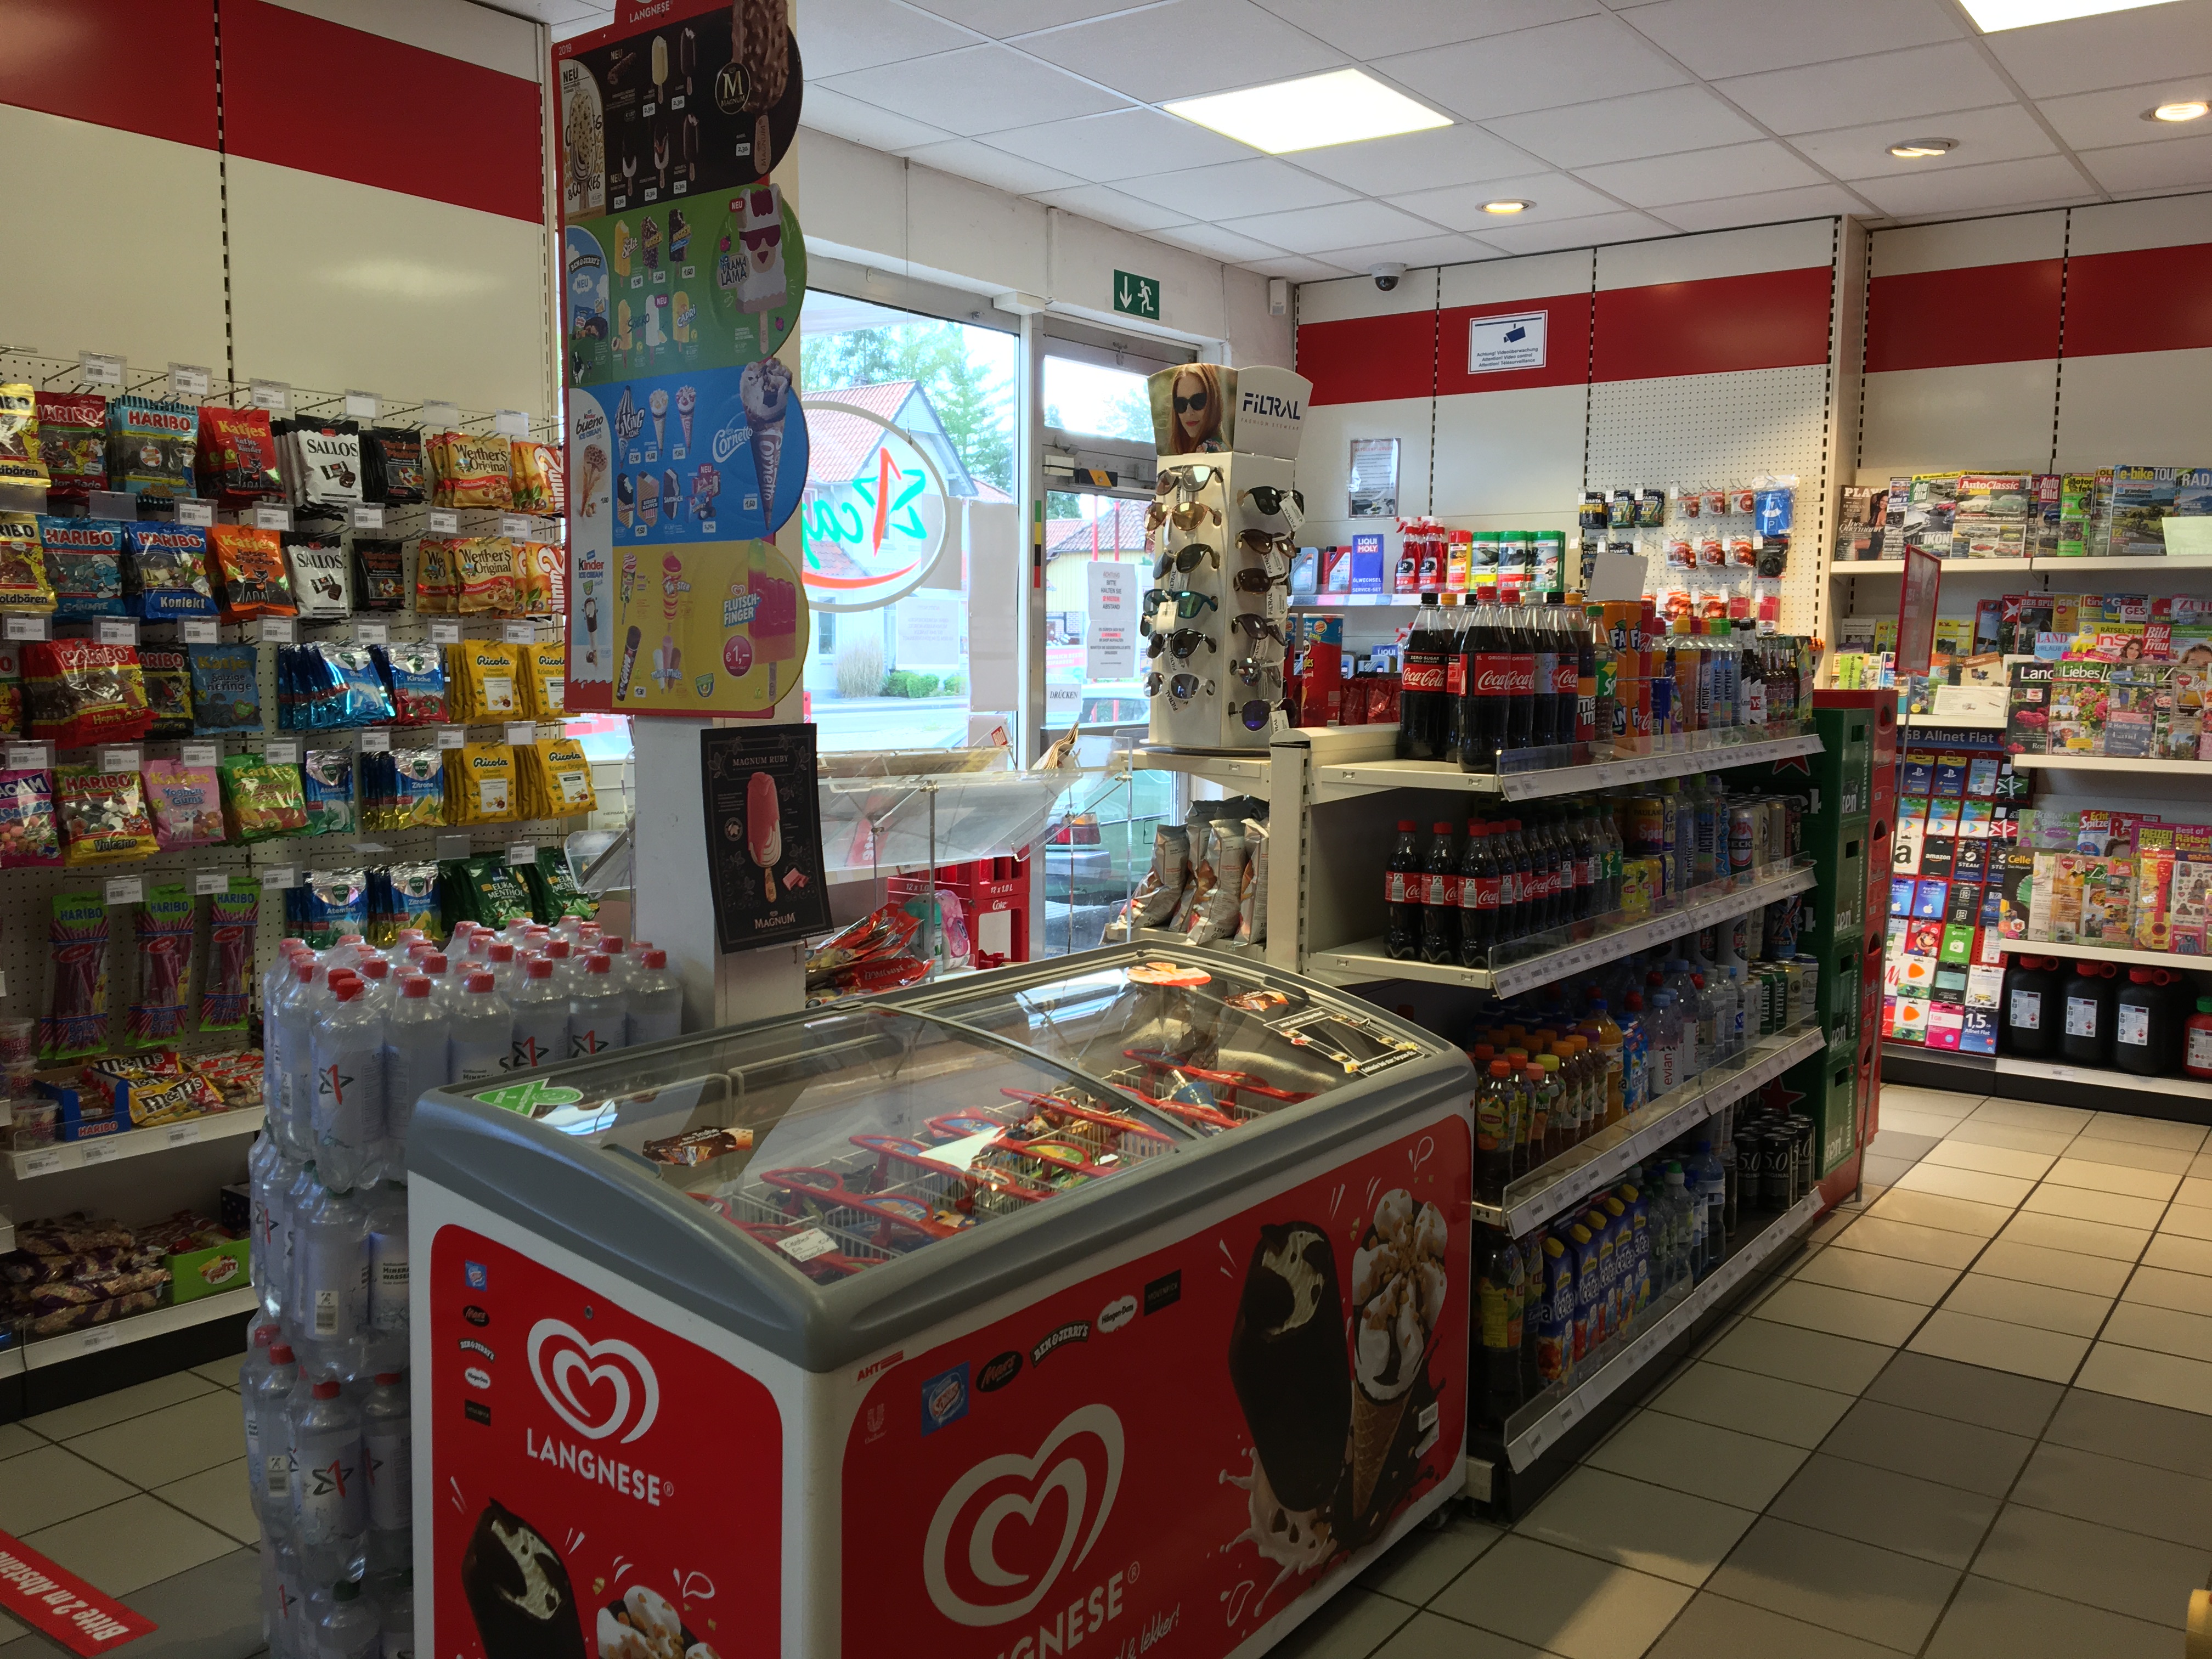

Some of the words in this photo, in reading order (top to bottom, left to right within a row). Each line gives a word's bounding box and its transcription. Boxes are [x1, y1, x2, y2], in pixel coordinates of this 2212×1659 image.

[558, 43, 572, 54] 2019
[610, 49, 623, 60] NEU
[563, 68, 579, 83] NEU
[721, 95, 746, 107] MAGNUM
[610, 173, 622, 183] NEU
[731, 201, 743, 210] NEU
[720, 256, 729, 267] NO
[722, 257, 747, 273] DRAMA
[576, 278, 589, 289] NEU
[720, 271, 747, 286] LAMA
[657, 297, 667, 305] NEU
[128, 410, 191, 431] HARIBO
[575, 417, 603, 435] bueno
[217, 420, 267, 437] Katjes
[307, 439, 359, 457] SALLOS
[713, 426, 753, 463] Cornetto
[453, 443, 508, 461] Werther's
[470, 460, 508, 473] Original
[759, 430, 782, 500] Cornetto
[2120, 467, 2153, 480] e-bike
[1914, 482, 1928, 493] Auto
[2040, 477, 2058, 489] Auto
[1914, 492, 1927, 501] Bild
[2042, 488, 2058, 499] Bild
[45, 528, 114, 546] HARIBO
[138, 532, 203, 548] HARIBO
[220, 535, 276, 551] Katjes
[296, 553, 343, 569] SALLOS
[459, 549, 512, 563] Werther's
[474, 561, 511, 575] Original
[578, 558, 604, 571] kinder
[160, 596, 205, 610] Konfekt
[724, 595, 760, 612] FLUTSCH-
[724, 607, 754, 625] FINGER
[2145, 627, 2171, 639] Bild
[2145, 641, 2169, 651] Frau
[61, 647, 129, 667] HARIBO
[477, 654, 511, 667] Ricola
[211, 673, 246, 682] Salzige
[407, 674, 432, 683] Kirsche
[1402, 667, 1445, 687] Coca-Cola
[1049, 689, 1078, 699] DRÜCKEN
[1925, 731, 1965, 742] Allnet
[1969, 732, 1994, 743] Flat
[473, 757, 507, 768] Ricola
[549, 751, 582, 763] Ricola
[732, 756, 768, 766] MAGNUM
[770, 755, 788, 763] RUBY
[65, 774, 132, 791] HARIBO
[150, 771, 211, 786] Katjes
[411, 781, 434, 789] Zitrone
[172, 795, 204, 806] Gums
[2090, 812, 2109, 821] Echt
[2175, 827, 2194, 835] Best
[94, 838, 137, 852] Vulcano
[2008, 854, 2032, 864] Celle
[217, 893, 255, 904] HARIBO
[488, 888, 525, 900] MENTHOL
[150, 901, 189, 913] HARIBO
[408, 897, 432, 905] Zitrone
[992, 900, 1007, 910] Coke
[60, 907, 103, 921] HARIBO
[326, 905, 356, 915] Atemfrei
[754, 912, 796, 929] MAGNUM
[1760, 985, 1770, 1022] VELTINS
[1776, 981, 1785, 1019] VELTINS
[1663, 1052, 1673, 1086] evian
[1481, 1114, 1502, 1123] Lipton
[78, 1121, 119, 1137] HARIBO
[1764, 1152, 1788, 1171] 5,0
[857, 1363, 882, 1382] AHT
[527, 1427, 661, 1506] LANGNESE
[42, 1589, 76, 1606] m
[52, 1599, 88, 1615] 2
[71, 1607, 129, 1641] Bitte
[1140, 1601, 1181, 1654] lekker!
